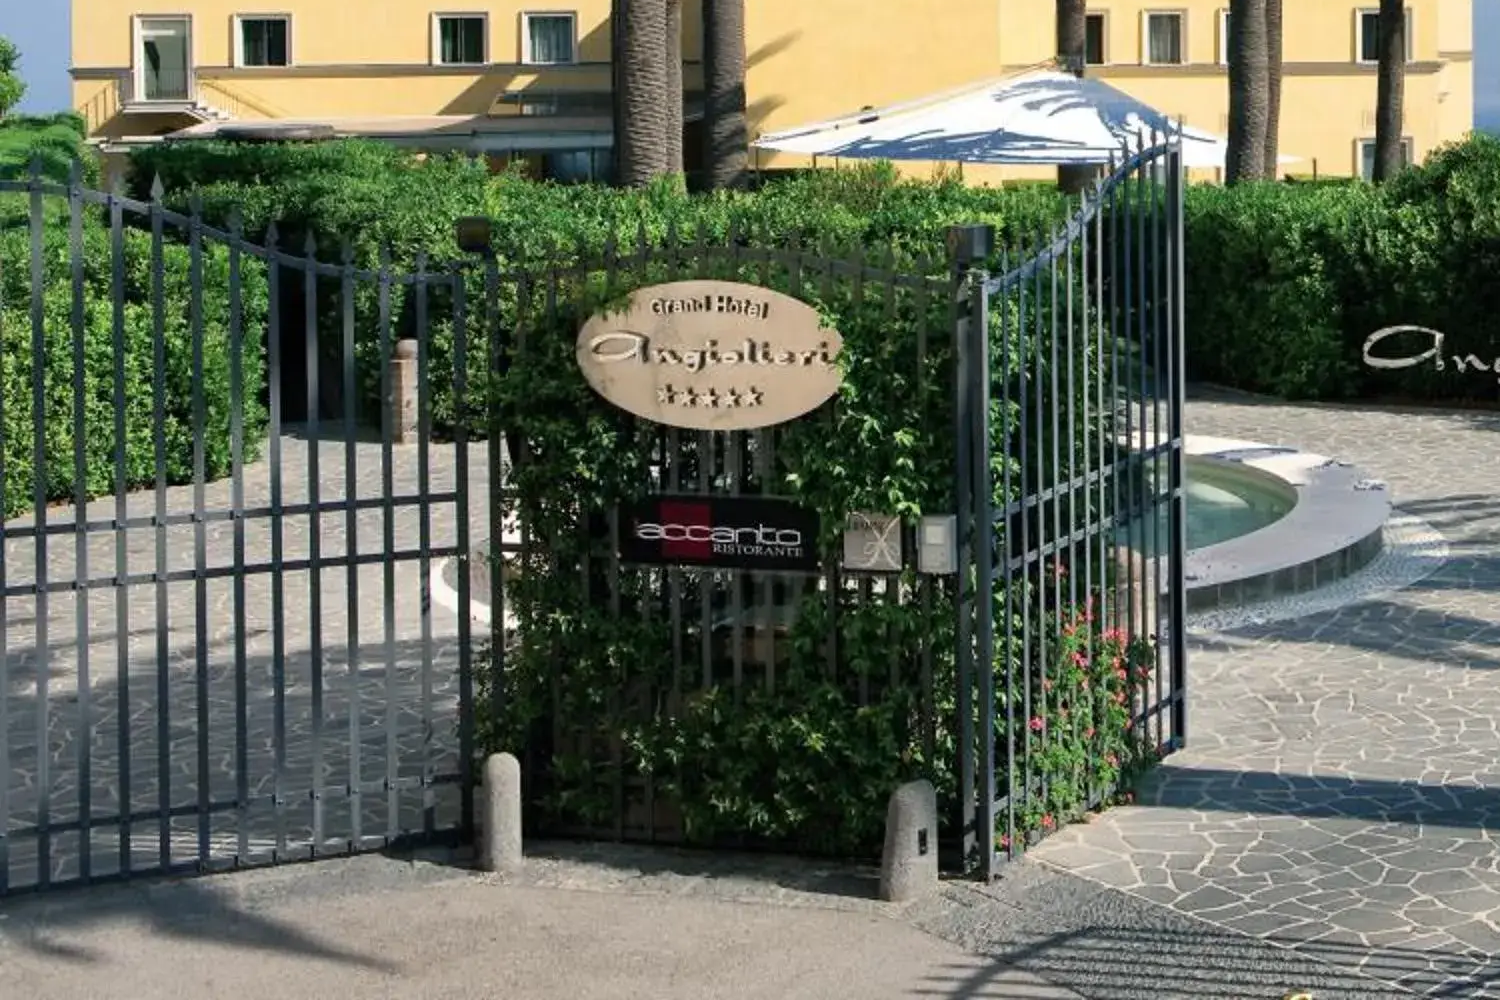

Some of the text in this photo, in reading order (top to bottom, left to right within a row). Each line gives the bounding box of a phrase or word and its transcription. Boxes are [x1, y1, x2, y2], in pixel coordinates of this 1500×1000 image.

[650, 295, 769, 320] Grand Hotel
[636, 523, 801, 546] accanto
[713, 543, 802, 557] RISTORANTE
